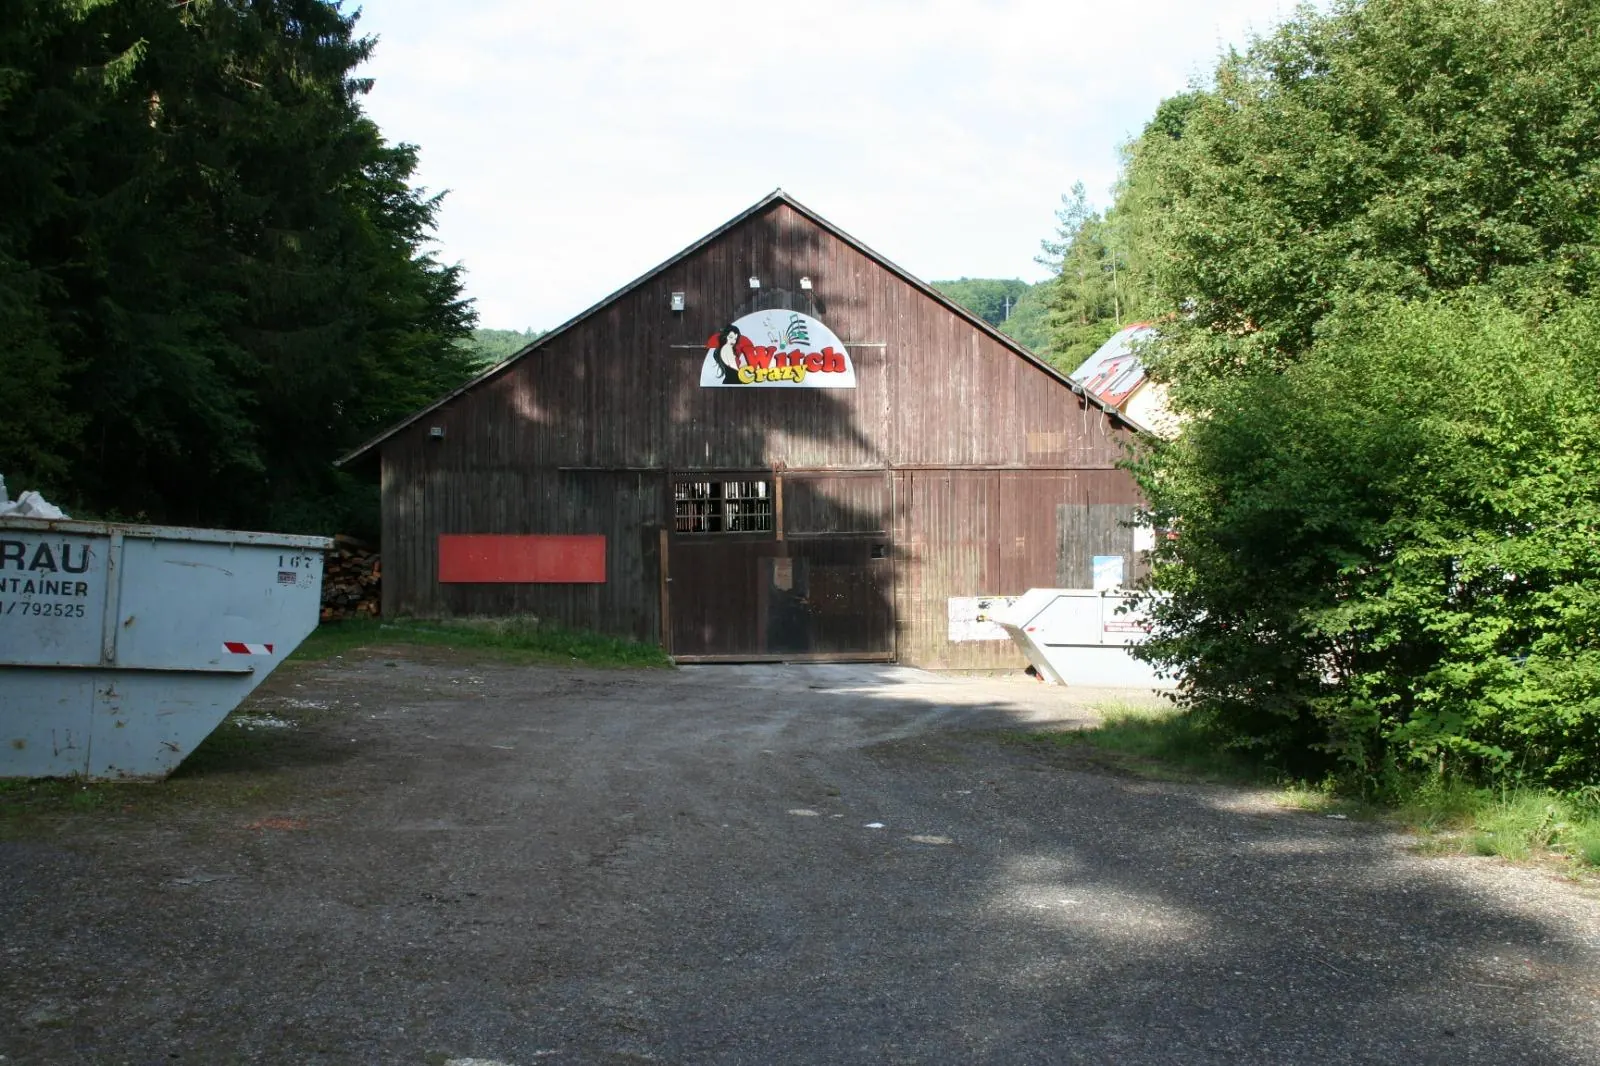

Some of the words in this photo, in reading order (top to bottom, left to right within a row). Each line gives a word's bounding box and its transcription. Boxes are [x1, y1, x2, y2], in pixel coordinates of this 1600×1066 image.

[742, 346, 846, 373] Witch
[738, 364, 807, 384] Crazy
[0, 541, 90, 574] RAU
[279, 555, 313, 569] 167
